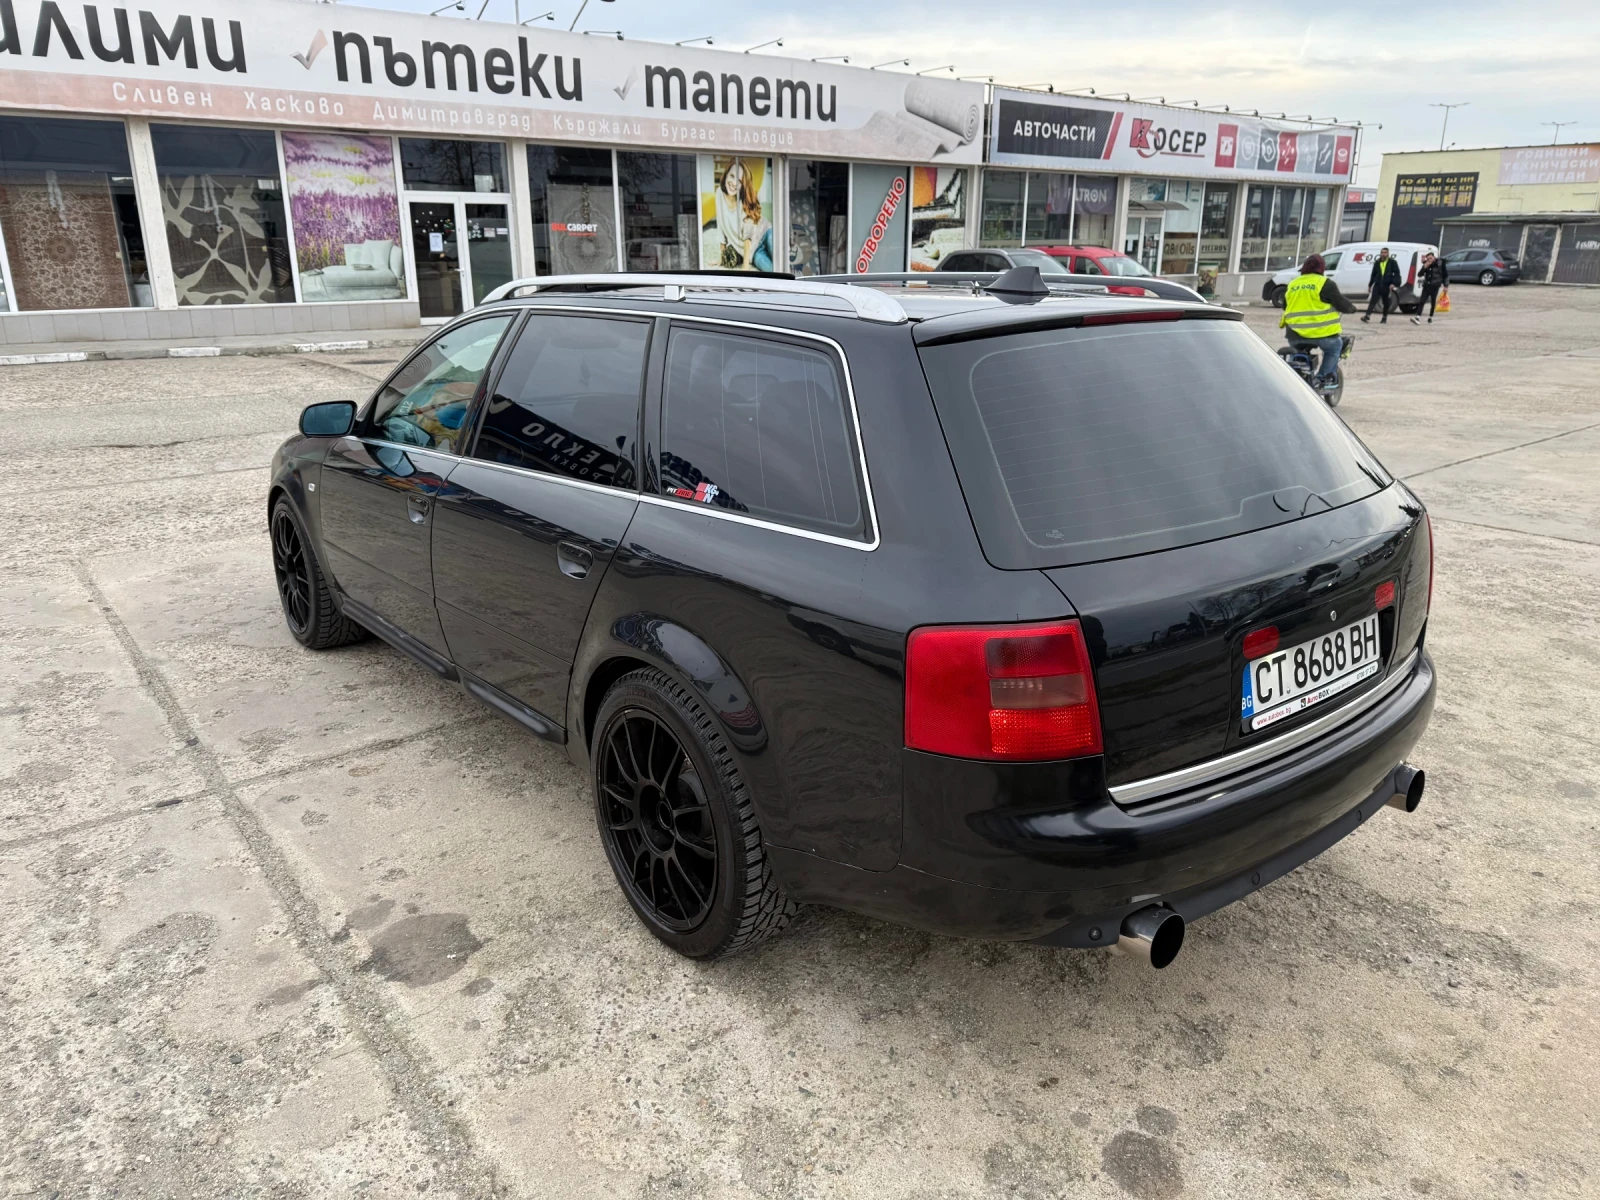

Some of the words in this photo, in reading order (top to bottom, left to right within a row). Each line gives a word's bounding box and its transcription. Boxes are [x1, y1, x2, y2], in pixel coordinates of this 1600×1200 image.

[332, 30, 583, 101] пътеки
[645, 64, 837, 122] тапети
[112, 81, 213, 107] Сливен
[243, 91, 344, 116] Хасково
[373, 102, 531, 132] Димитровград
[553, 114, 642, 137] Кърджали
[661, 121, 716, 143] Бургас
[733, 128, 794, 148] Пловдив
[1013, 118, 1096, 143] АВТОЧАСТИ
[1129, 117, 1207, 155] КОСЕР
[1504, 159, 1599, 170] ТЕХНИЧЕСКИ
[1516, 147, 1589, 159] ГОДИШНИ
[856, 176, 906, 274] ОТВОРЕНО
[1180, 242, 1195, 255] Oils
[1255, 653, 1287, 704] CT
[1293, 631, 1347, 689] 8688
[1350, 617, 1377, 665] BH
[1241, 695, 1252, 710] BG
